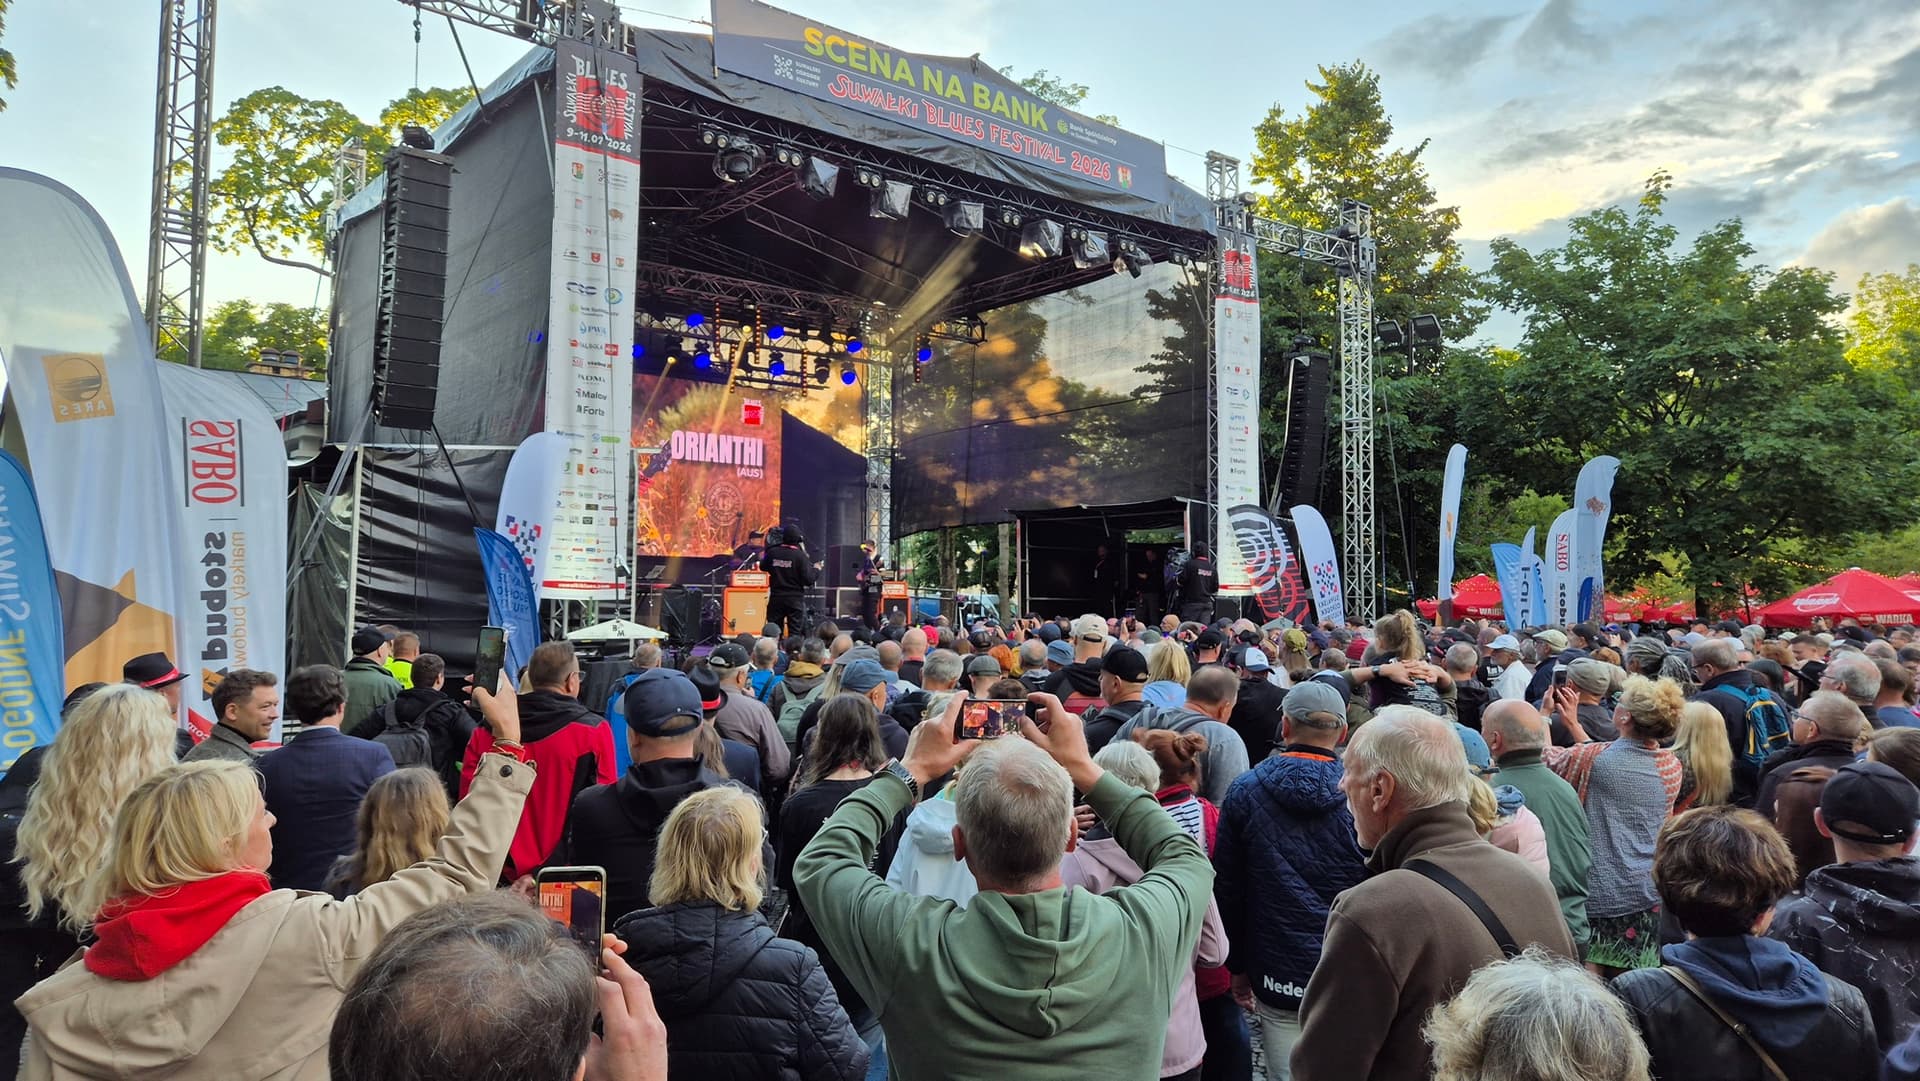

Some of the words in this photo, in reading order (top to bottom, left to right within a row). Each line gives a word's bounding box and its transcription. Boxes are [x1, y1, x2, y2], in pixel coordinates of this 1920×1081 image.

[802, 26, 916, 88] SCENA
[922, 64, 968, 104] NA
[972, 83, 1049, 132] BANK
[922, 99, 984, 141] BLUES
[990, 121, 1066, 165] FESTIVAL
[1071, 151, 1112, 182] 2026
[671, 430, 764, 467] ORIANTHI
[736, 467, 763, 479] (AUS)
[1875, 613, 1914, 624] WARKA
